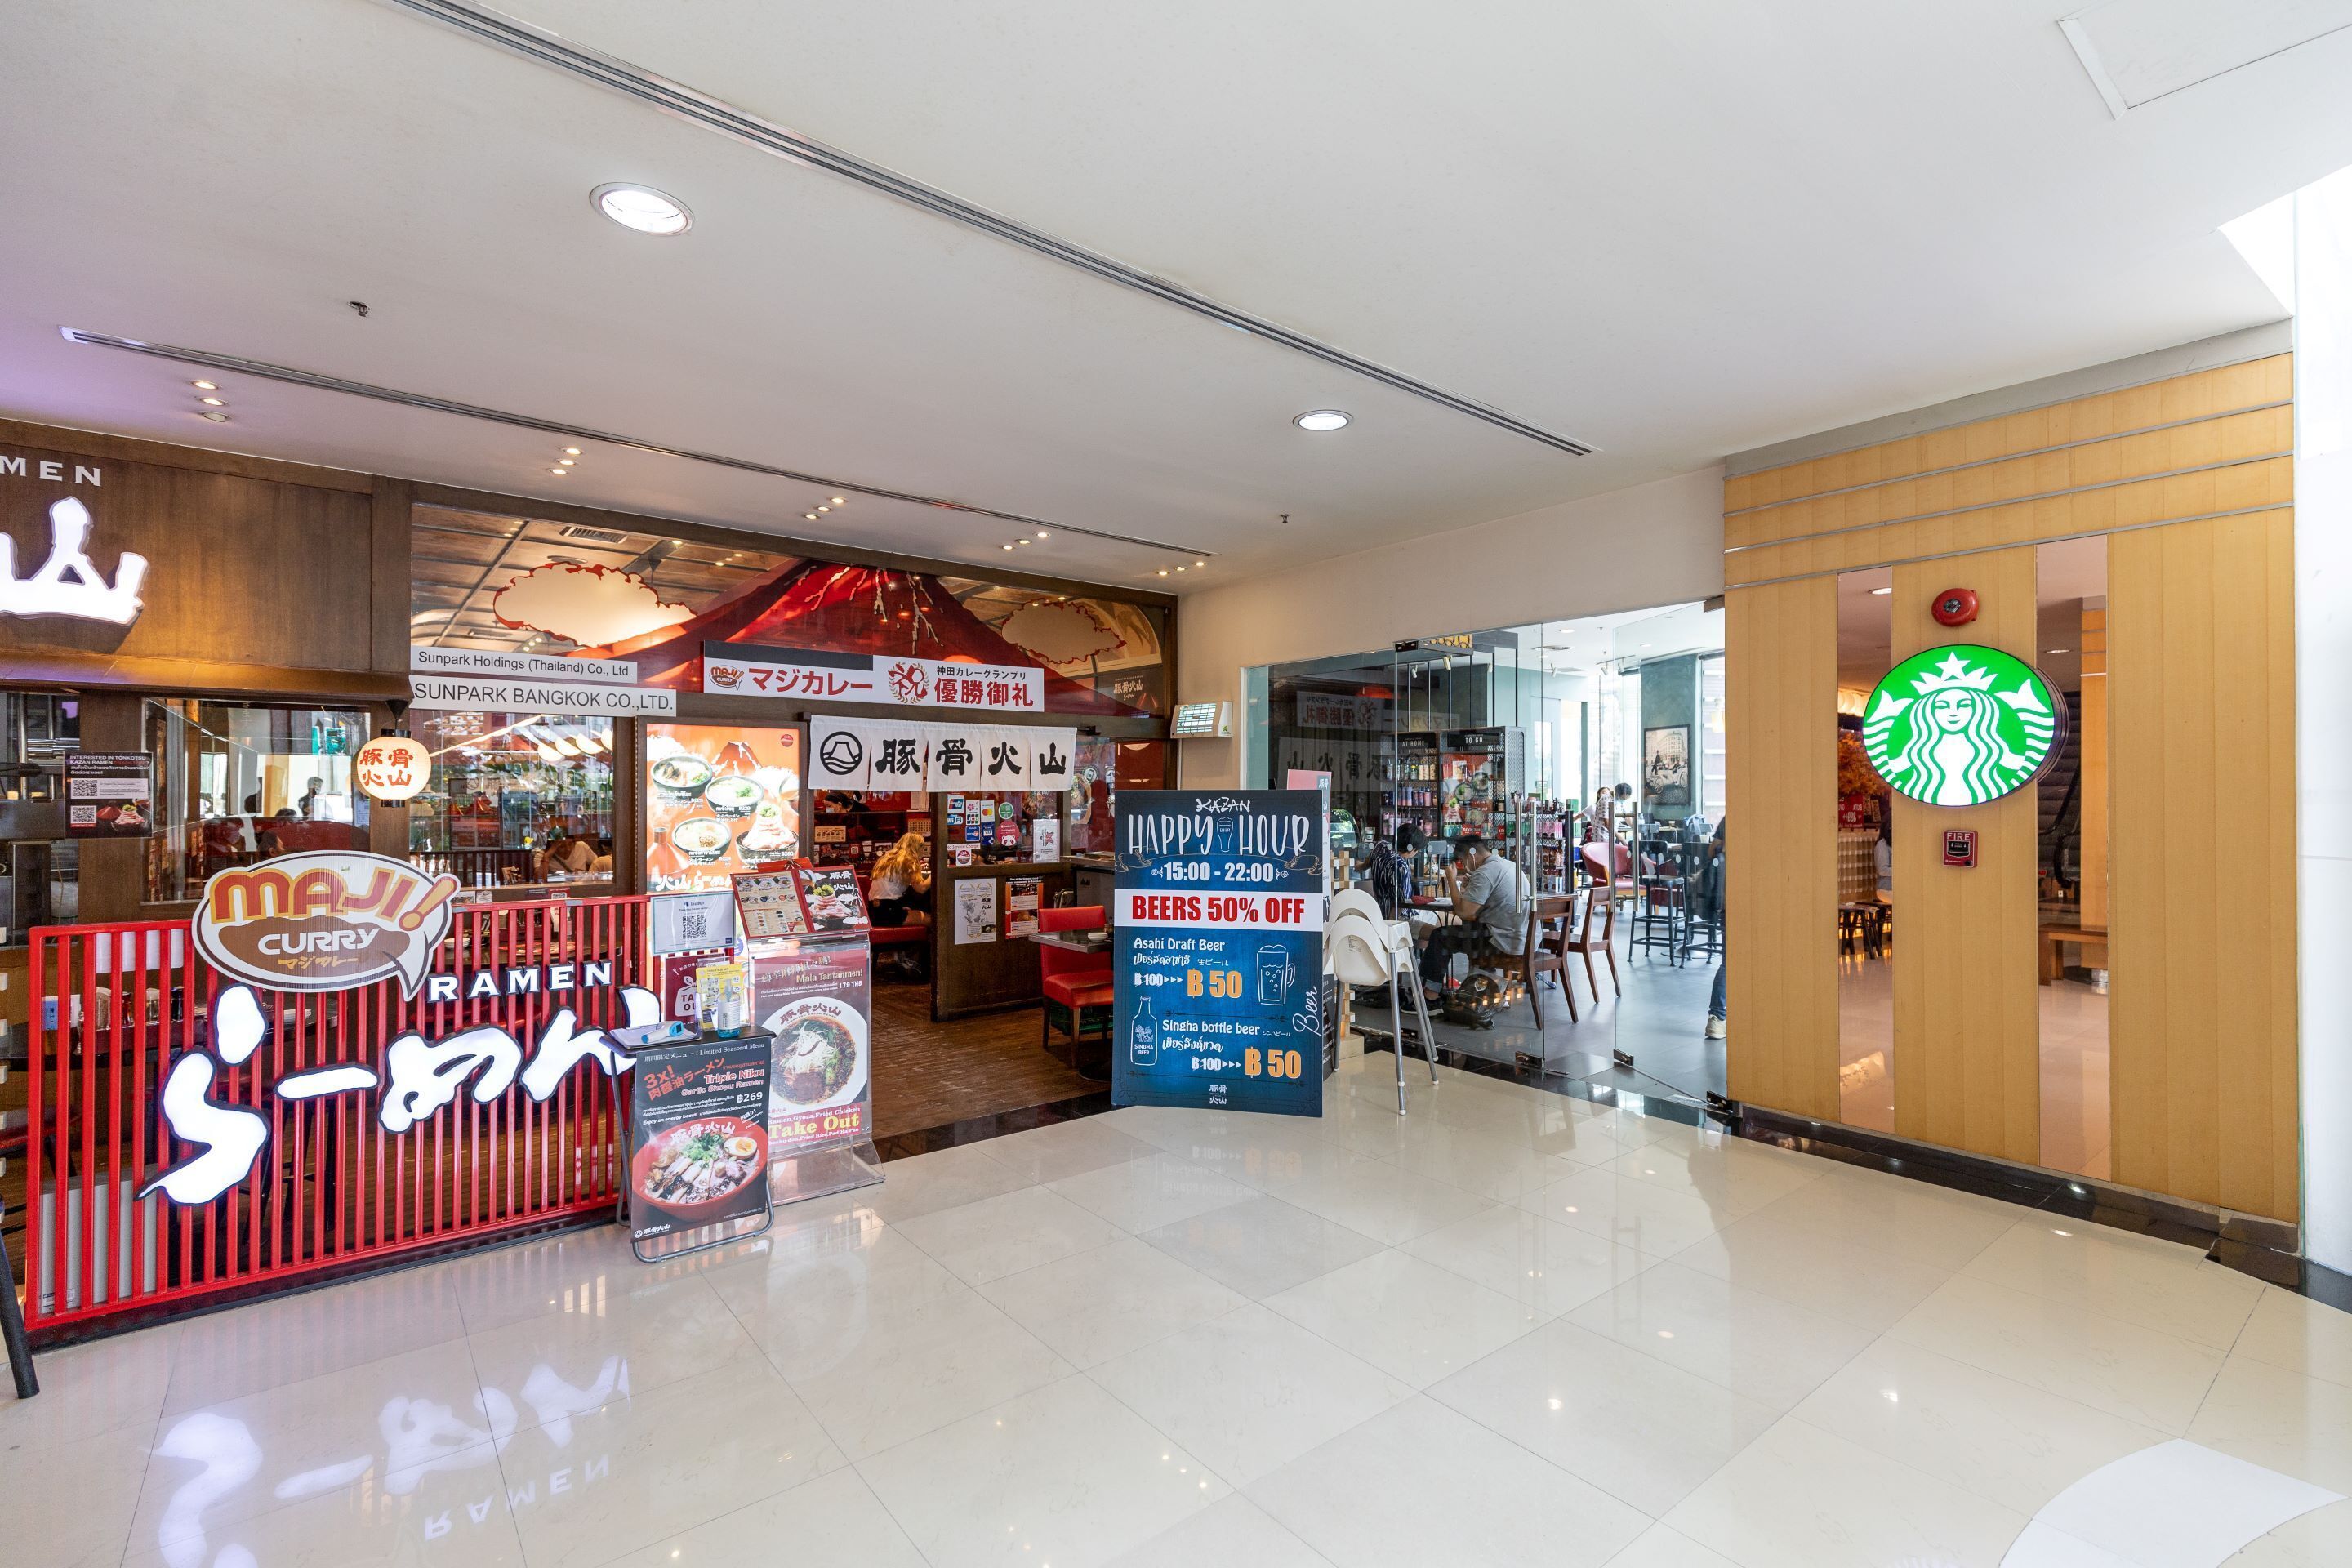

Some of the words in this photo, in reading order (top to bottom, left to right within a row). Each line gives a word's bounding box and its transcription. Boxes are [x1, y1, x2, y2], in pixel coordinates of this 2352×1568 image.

[417, 650, 470, 668] Sunpark
[474, 654, 525, 671] Holdings
[528, 657, 585, 675] (Thailand)
[586, 662, 609, 676] Co.,
[612, 664, 632, 676] Ltd.
[936, 665, 1027, 680] 神田カレーグランプリ
[748, 666, 874, 697] マジカレー
[889, 662, 929, 698] 祝
[414, 683, 508, 703] SUNPARK
[513, 686, 602, 708] BANGKOK
[606, 692, 674, 711] CO.,LTD.
[933, 677, 1034, 707] 優勝御礼
[359, 748, 414, 768] 豚骨
[875, 737, 1067, 776] 豚骨火山
[362, 769, 412, 786] 火山
[1196, 796, 1250, 813] KAZAN
[1129, 814, 1214, 856] HAPPY
[1239, 814, 1310, 856] HOUR
[1947, 832, 1971, 840] FIRE
[1163, 862, 1210, 881] 15:00
[1224, 862, 1274, 882] 22:00
[1132, 895, 1201, 921] BEERS
[1207, 897, 1259, 923] 50%
[1265, 898, 1305, 924] OFF
[257, 926, 381, 953] CURRY
[1134, 938, 1165, 950] Asahi
[1167, 938, 1196, 951] Draft
[1199, 938, 1225, 951] Beer
[276, 952, 360, 970] マジカレー
[1197, 958, 1229, 966] 生ビール
[426, 960, 612, 1004] RAMEN
[796, 973, 817, 983] Mala
[819, 968, 863, 981] Tantanmen!
[1209, 970, 1243, 999] 50
[680, 993, 697, 1002] TA
[780, 1002, 842, 1025] 豚骨火山
[1292, 986, 1322, 1037] Beer
[1162, 1019, 1198, 1034] Singha
[1201, 1021, 1233, 1034] bottle
[1236, 1022, 1260, 1036] beer
[700, 1047, 722, 1056] Limited
[723, 1045, 748, 1053] Seasonal
[1267, 1049, 1302, 1079] 50
[644, 1064, 675, 1089] 3x!
[704, 1072, 737, 1085] Triple
[738, 1068, 764, 1079] Niku
[134, 983, 662, 1206] らーめん
[681, 1087, 706, 1097] Garlic
[708, 1083, 734, 1094] Shoyu
[735, 1079, 764, 1089] Ramen
[1209, 1095, 1227, 1105] 火山
[835, 1106, 861, 1116] Chicken
[769, 1120, 817, 1139] Take
[823, 1113, 860, 1130] Out
